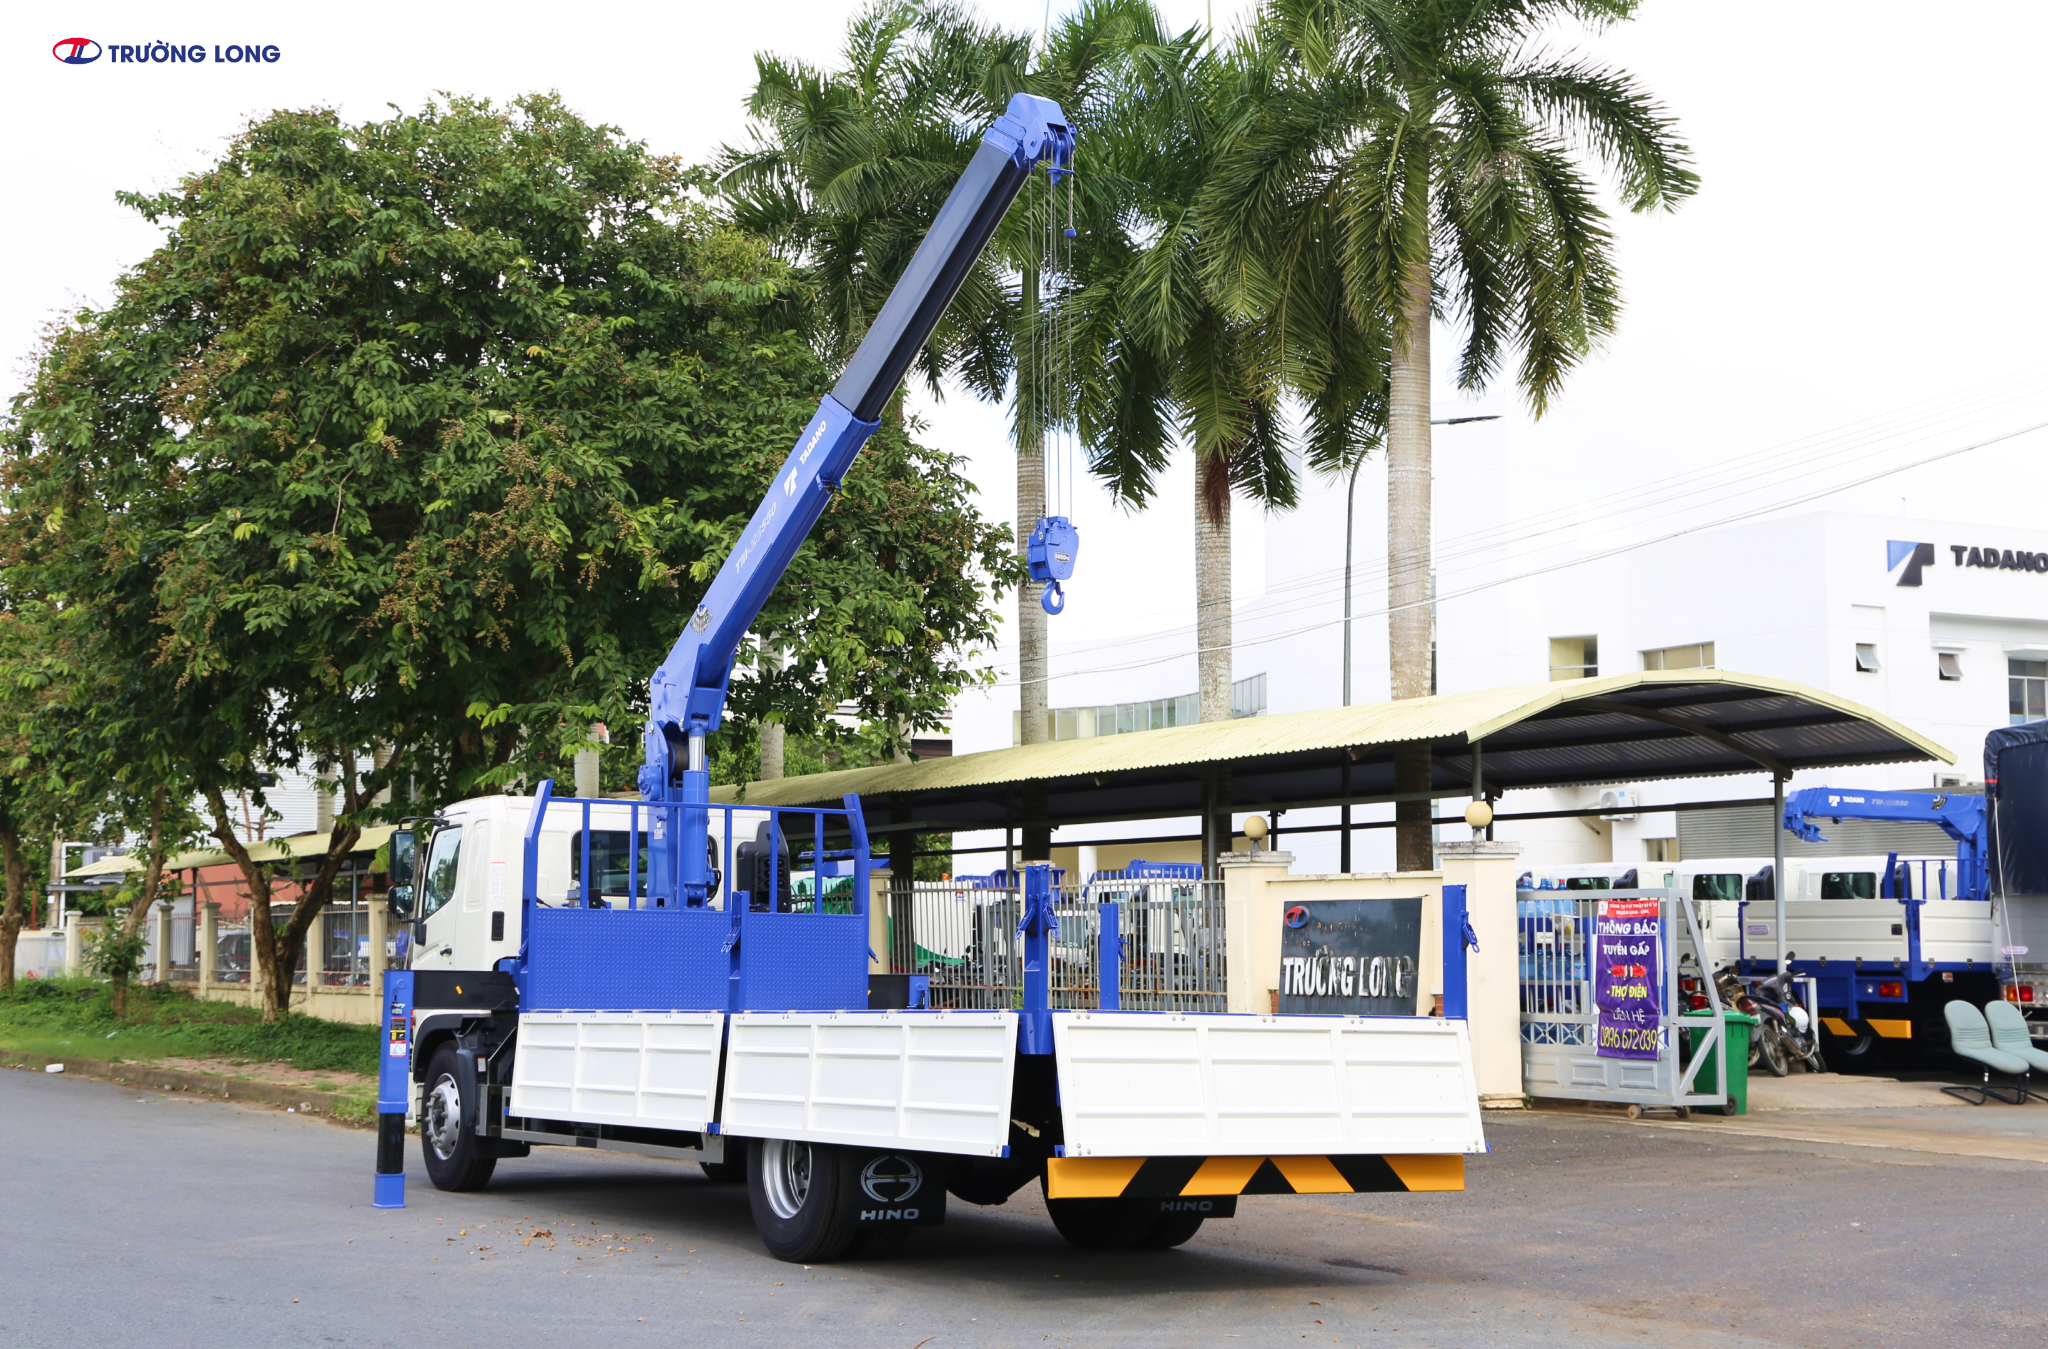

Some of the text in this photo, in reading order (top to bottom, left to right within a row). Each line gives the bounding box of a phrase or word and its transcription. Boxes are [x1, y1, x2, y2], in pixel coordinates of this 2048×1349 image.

[799, 420, 827, 465] TADANO
[1950, 545, 2048, 574] TADANO
[1842, 796, 1865, 804] TADANO
[1598, 919, 1658, 934] THÔNG BÁO
[1603, 940, 1650, 955] TUYỂN GẤP
[1283, 945, 1414, 998] TRƯỜNG LONG
[1611, 983, 1648, 1001] THỢ ĐIỆN
[1611, 1007, 1645, 1024] LIÊN HỆ
[1160, 1201, 1213, 1211] HINO
[860, 1208, 920, 1221] HINO
